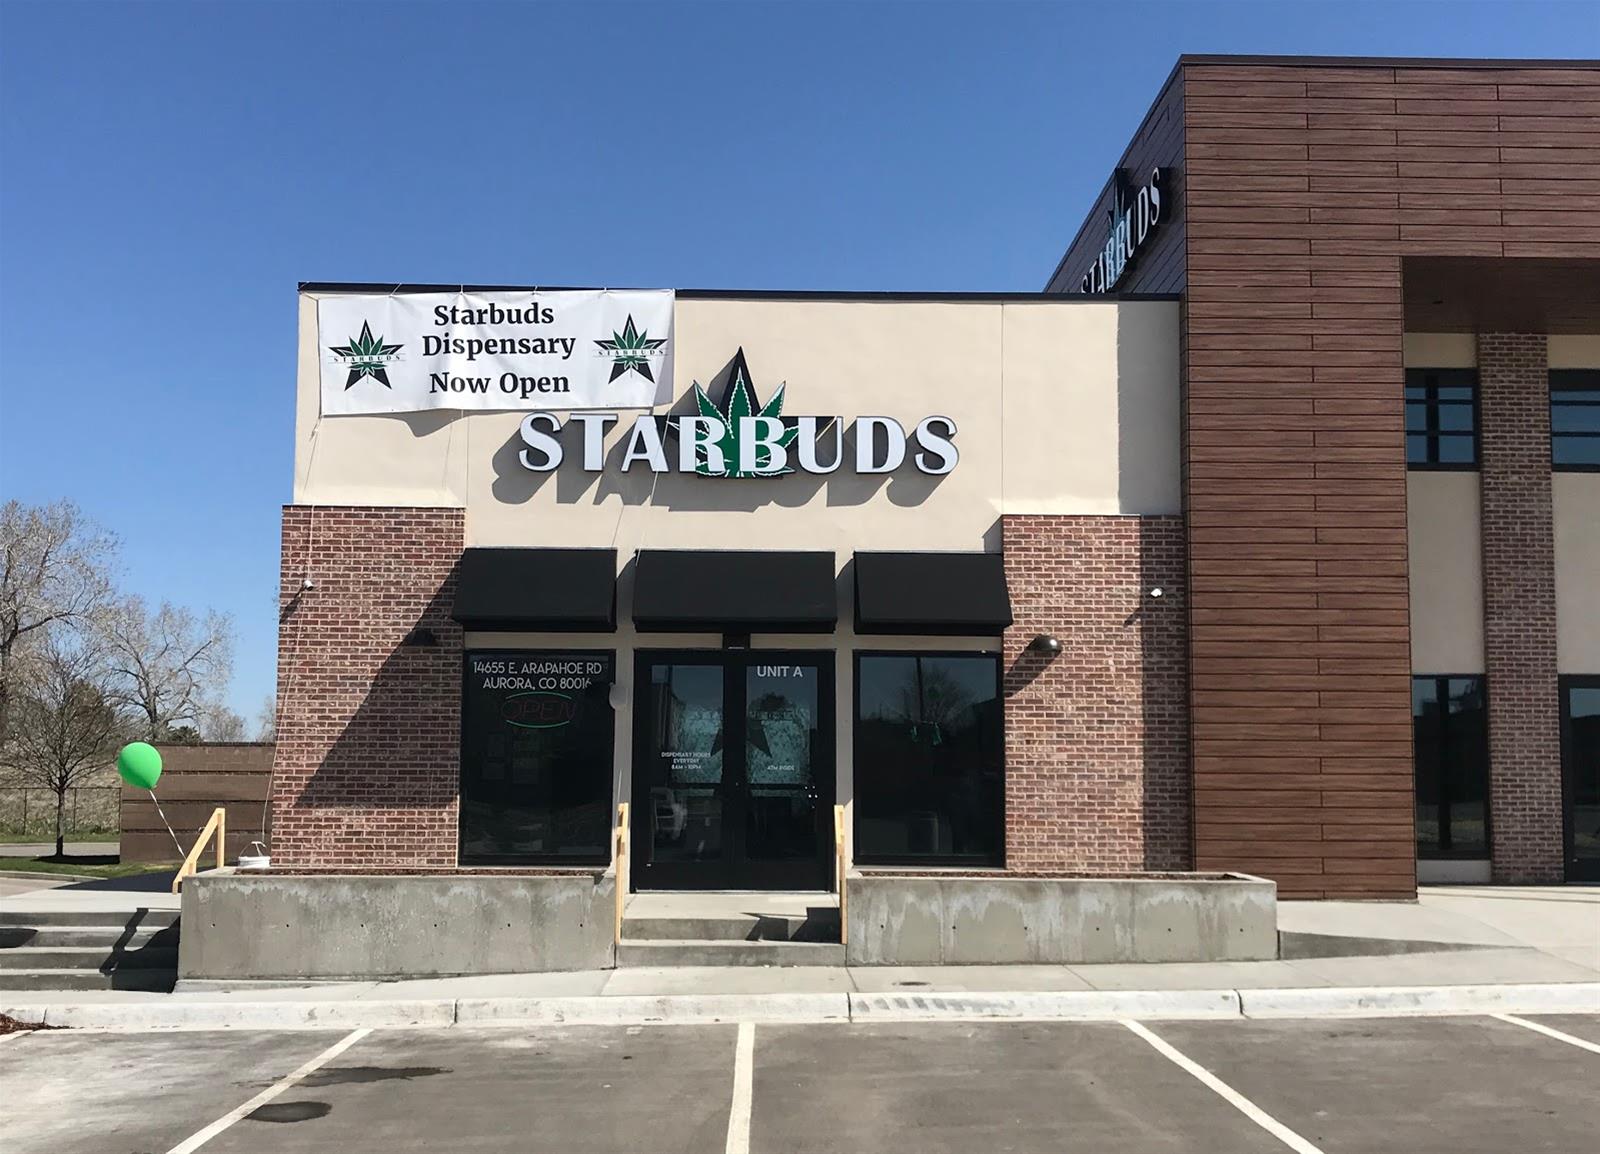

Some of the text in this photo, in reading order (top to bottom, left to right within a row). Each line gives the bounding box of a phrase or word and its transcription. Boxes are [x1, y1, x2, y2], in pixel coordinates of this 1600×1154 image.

[434, 302, 555, 327] Starbuds
[422, 331, 577, 361] Dispensary
[598, 348, 665, 357] STARBUDS
[333, 353, 402, 363] STARBUDS
[429, 371, 571, 400] Now Open
[517, 411, 960, 476] STARBUDS
[474, 661, 602, 675] 14655 E. ARAPAHOE RD
[756, 665, 803, 678] UNIT A
[482, 677, 536, 691] AURORA,
[538, 677, 557, 690] CO
[502, 700, 577, 721] OPEN
